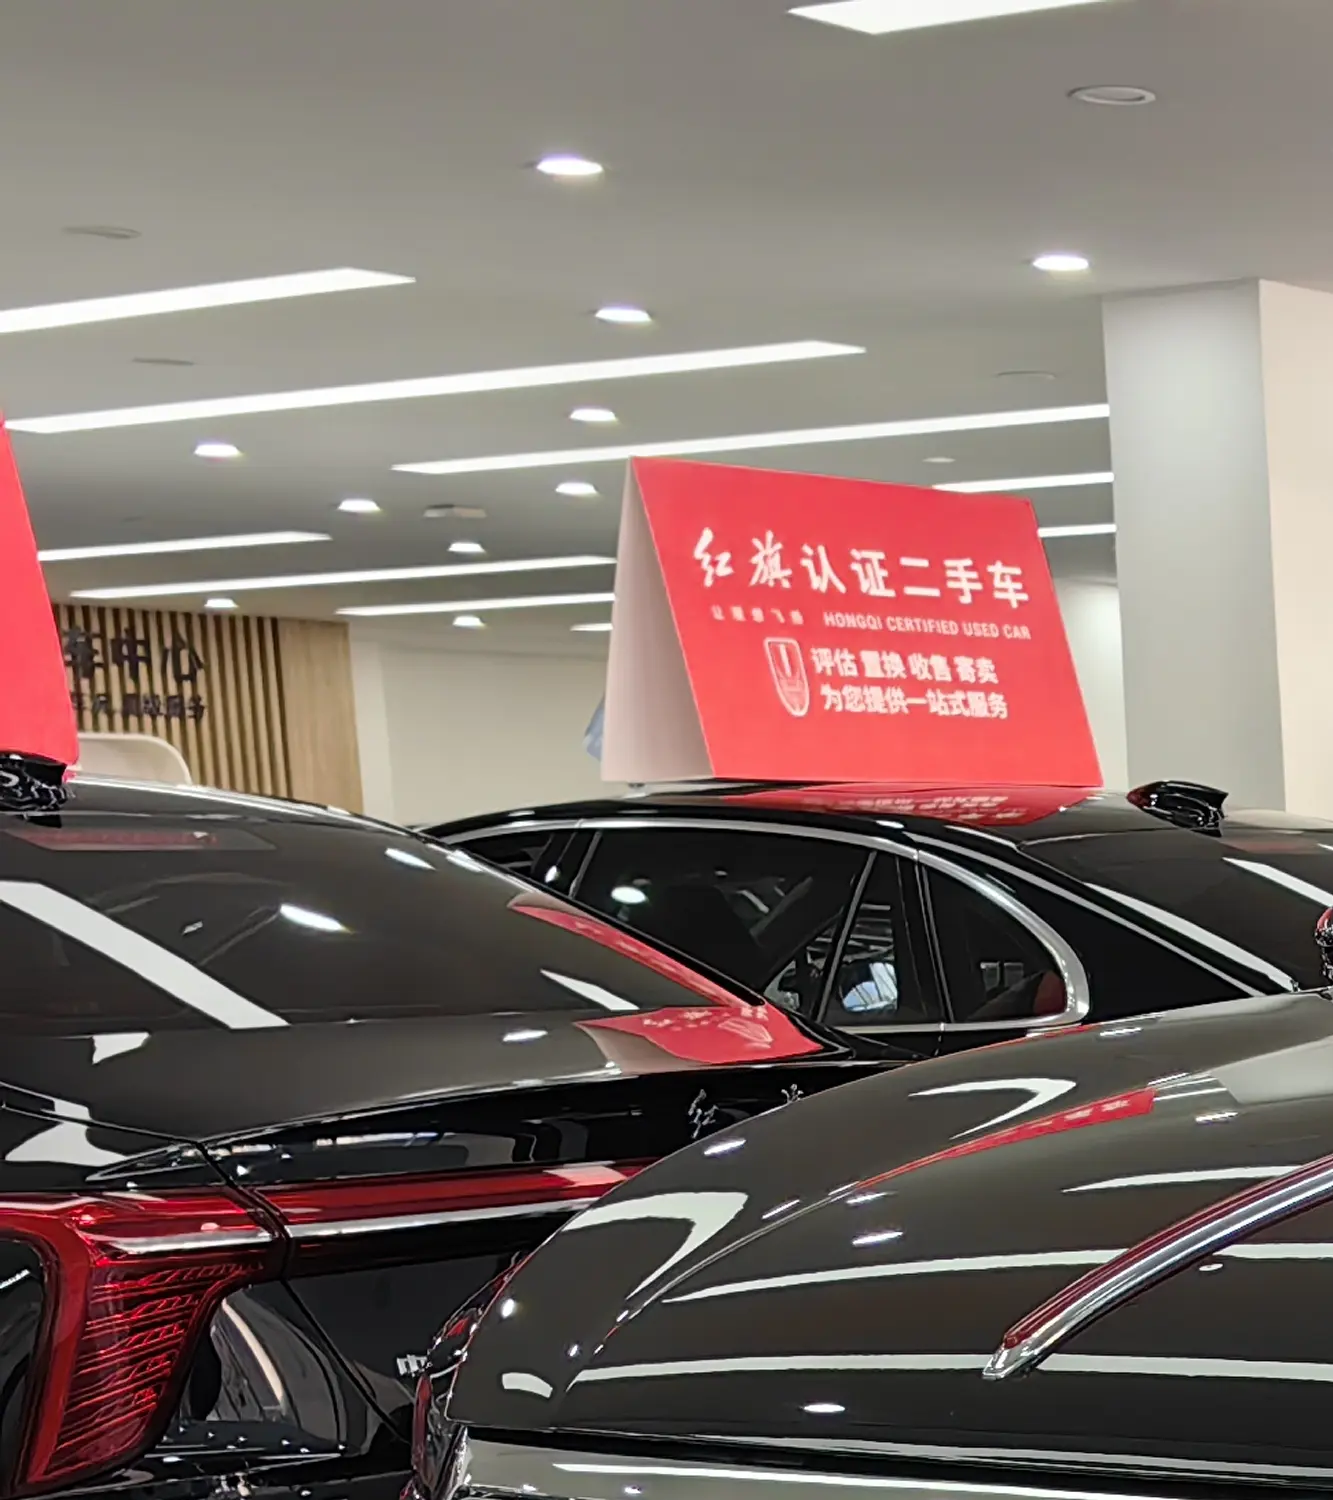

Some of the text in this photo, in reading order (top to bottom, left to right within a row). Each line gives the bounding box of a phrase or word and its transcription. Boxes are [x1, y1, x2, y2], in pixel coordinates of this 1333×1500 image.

[694, 528, 1028, 608] 红旗认证二手车
[824, 612, 882, 630] HONGQI
[886, 616, 959, 635] CERTIFIED
[962, 622, 999, 638] USED
[1003, 625, 1030, 639] CAR
[811, 648, 858, 676] 评估
[821, 684, 1007, 719] 为您提供一站式服务
